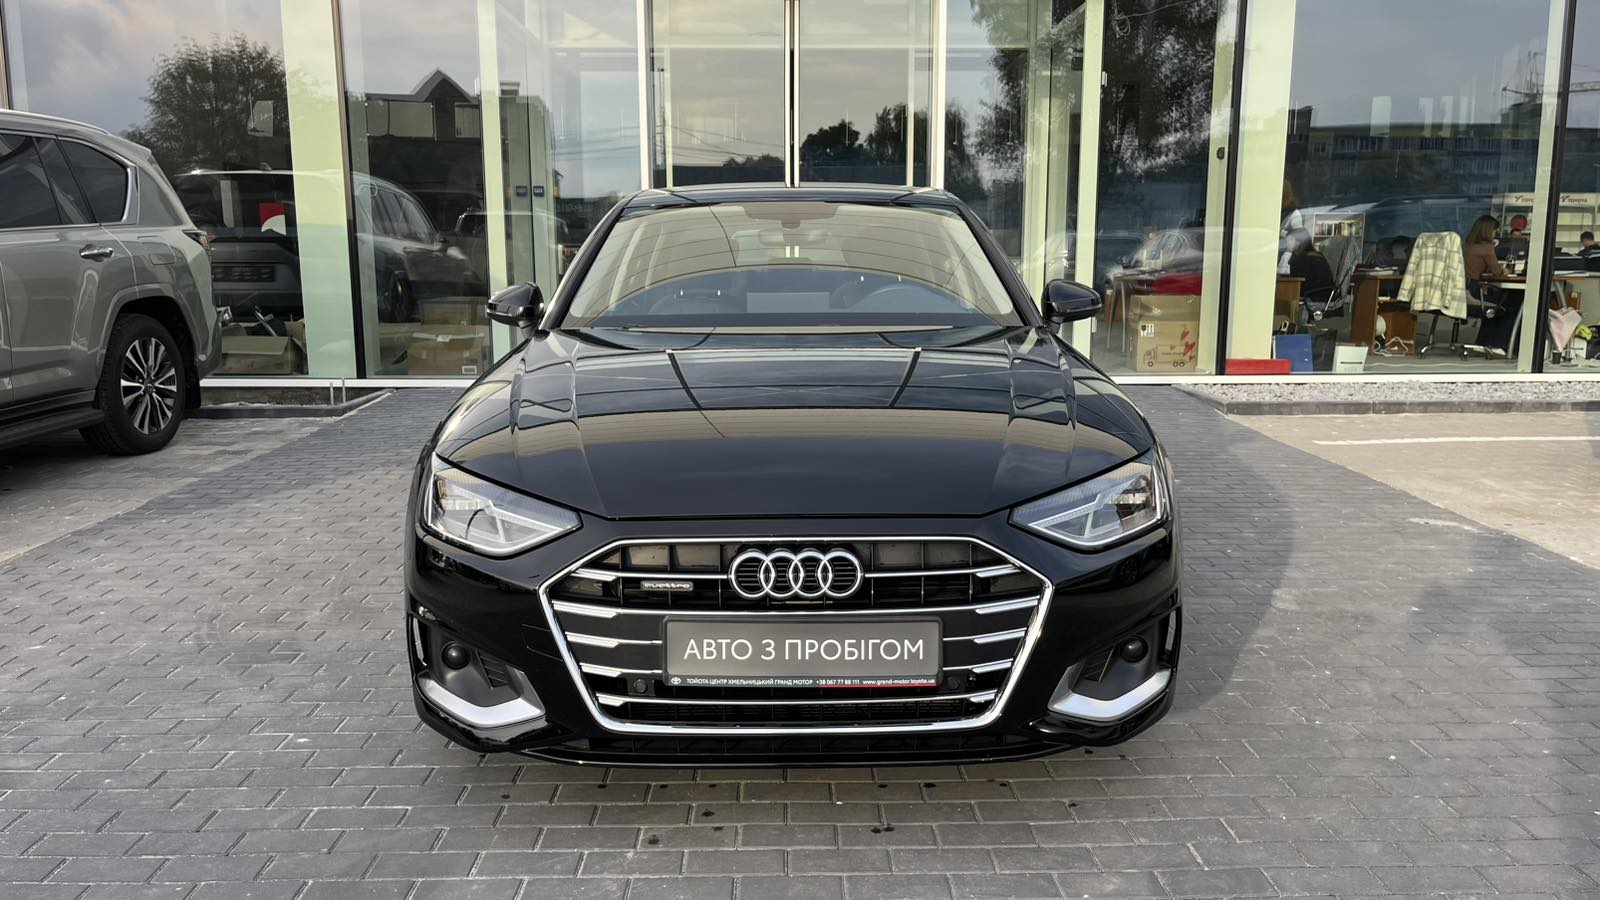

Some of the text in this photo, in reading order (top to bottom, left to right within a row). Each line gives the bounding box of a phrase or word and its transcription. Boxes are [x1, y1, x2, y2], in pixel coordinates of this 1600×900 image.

[683, 638, 753, 660] АВТО
[784, 638, 924, 660] ПРОБІГОМ
[686, 677, 709, 685] ТОЙОТА
[709, 678, 728, 686] ЦЕНТР
[727, 678, 774, 686] ХМЕЛЬНИЦЬКИЙ
